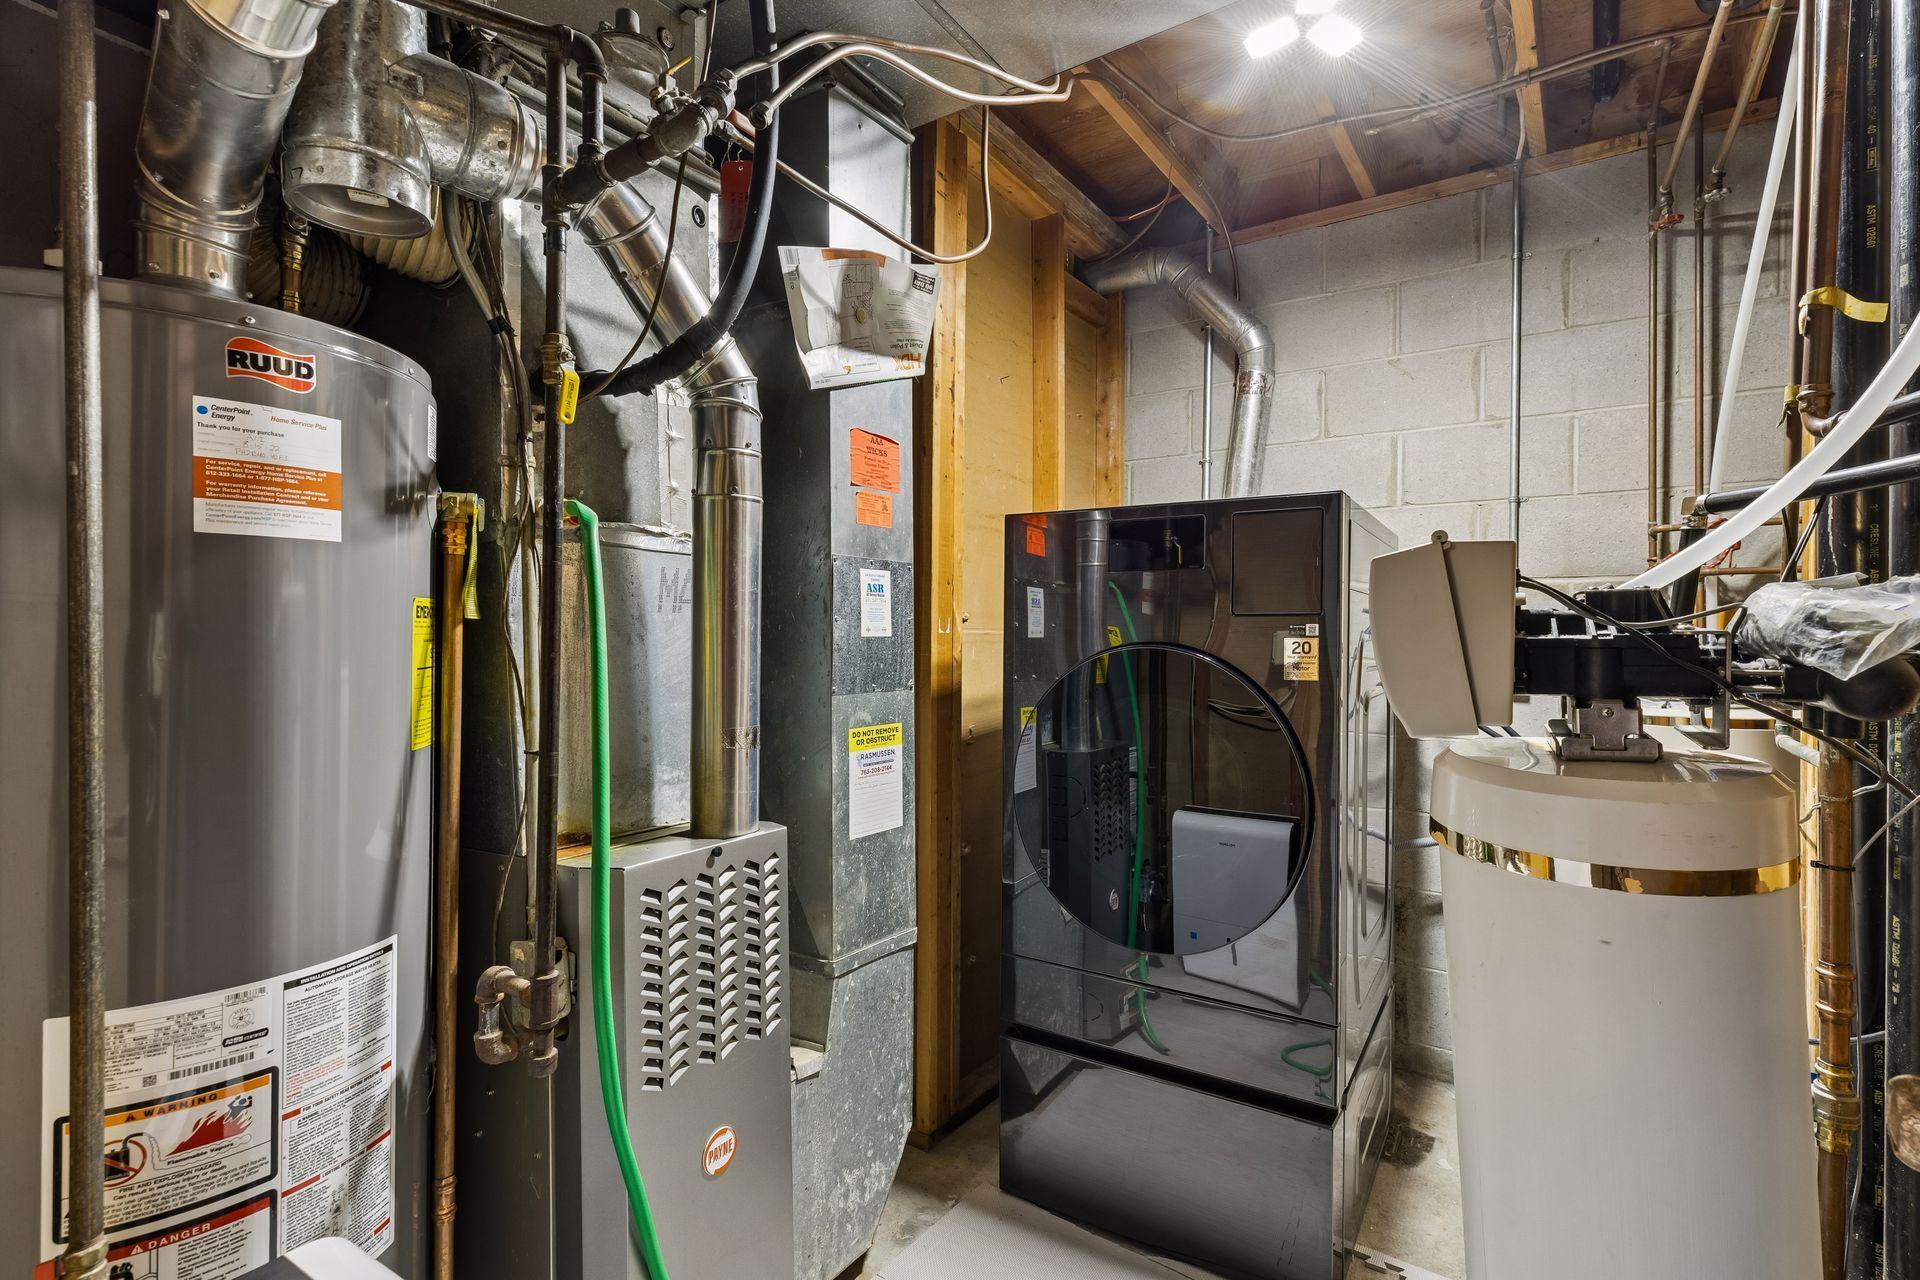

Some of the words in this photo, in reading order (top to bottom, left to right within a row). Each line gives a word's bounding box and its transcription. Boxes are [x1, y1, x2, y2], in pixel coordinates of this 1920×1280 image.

[1867, 124, 1877, 134] 40
[1865, 204, 1876, 225] ASTM
[1865, 227, 1876, 249] D2661
[227, 349, 314, 379] RUUD
[211, 405, 251, 415] CenterPoint
[211, 413, 235, 421] Energy
[271, 416, 289, 424] Home
[291, 419, 314, 428] Service
[315, 423, 327, 431] Plus
[257, 430, 284, 438] purchase
[870, 437, 884, 446] AAA
[866, 446, 888, 457] WICKS
[206, 464, 243, 473] CenterPoint
[245, 468, 265, 476] Energy
[285, 472, 305, 480] Service
[244, 462, 262, 470] repair,
[242, 489, 274, 497] Installation
[248, 484, 283, 492] information,
[206, 492, 246, 500] Merchandise
[867, 583, 884, 593] ASR
[1292, 641, 1311, 654] 20
[1869, 721, 1878, 740] ASTM
[866, 734, 895, 744] OBSTRUCT
[861, 749, 895, 760] RASMUSSEN
[1891, 915, 1901, 940] ASTM
[300, 969, 335, 984] INSTALLATION
[304, 979, 333, 992] AUTOMATIC
[334, 972, 353, 982] STORAGE
[355, 966, 367, 974] WATER
[368, 959, 381, 969] HEATER
[1873, 1043, 1883, 1079] CRESLINE
[325, 1093, 339, 1102] SAFETY
[1873, 1089, 1883, 1105] ABS
[144, 1094, 218, 1117] WARNING
[167, 1151, 207, 1166] Flammable
[210, 1142, 234, 1153] Vapors
[708, 1138, 733, 1165] PAYNE
[154, 1170, 193, 1184] EXPLOSION
[194, 1161, 222, 1172] HAZARD
[188, 1175, 218, 1186] flammable
[219, 1168, 238, 1176] vapors
[129, 1189, 147, 1197] result
[157, 1180, 180, 1189] serious
[182, 1174, 200, 1182] injury
[210, 1165, 227, 1173] death
[148, 1222, 211, 1249] DANGER
[1875, 1243, 1883, 1264] ASTM
